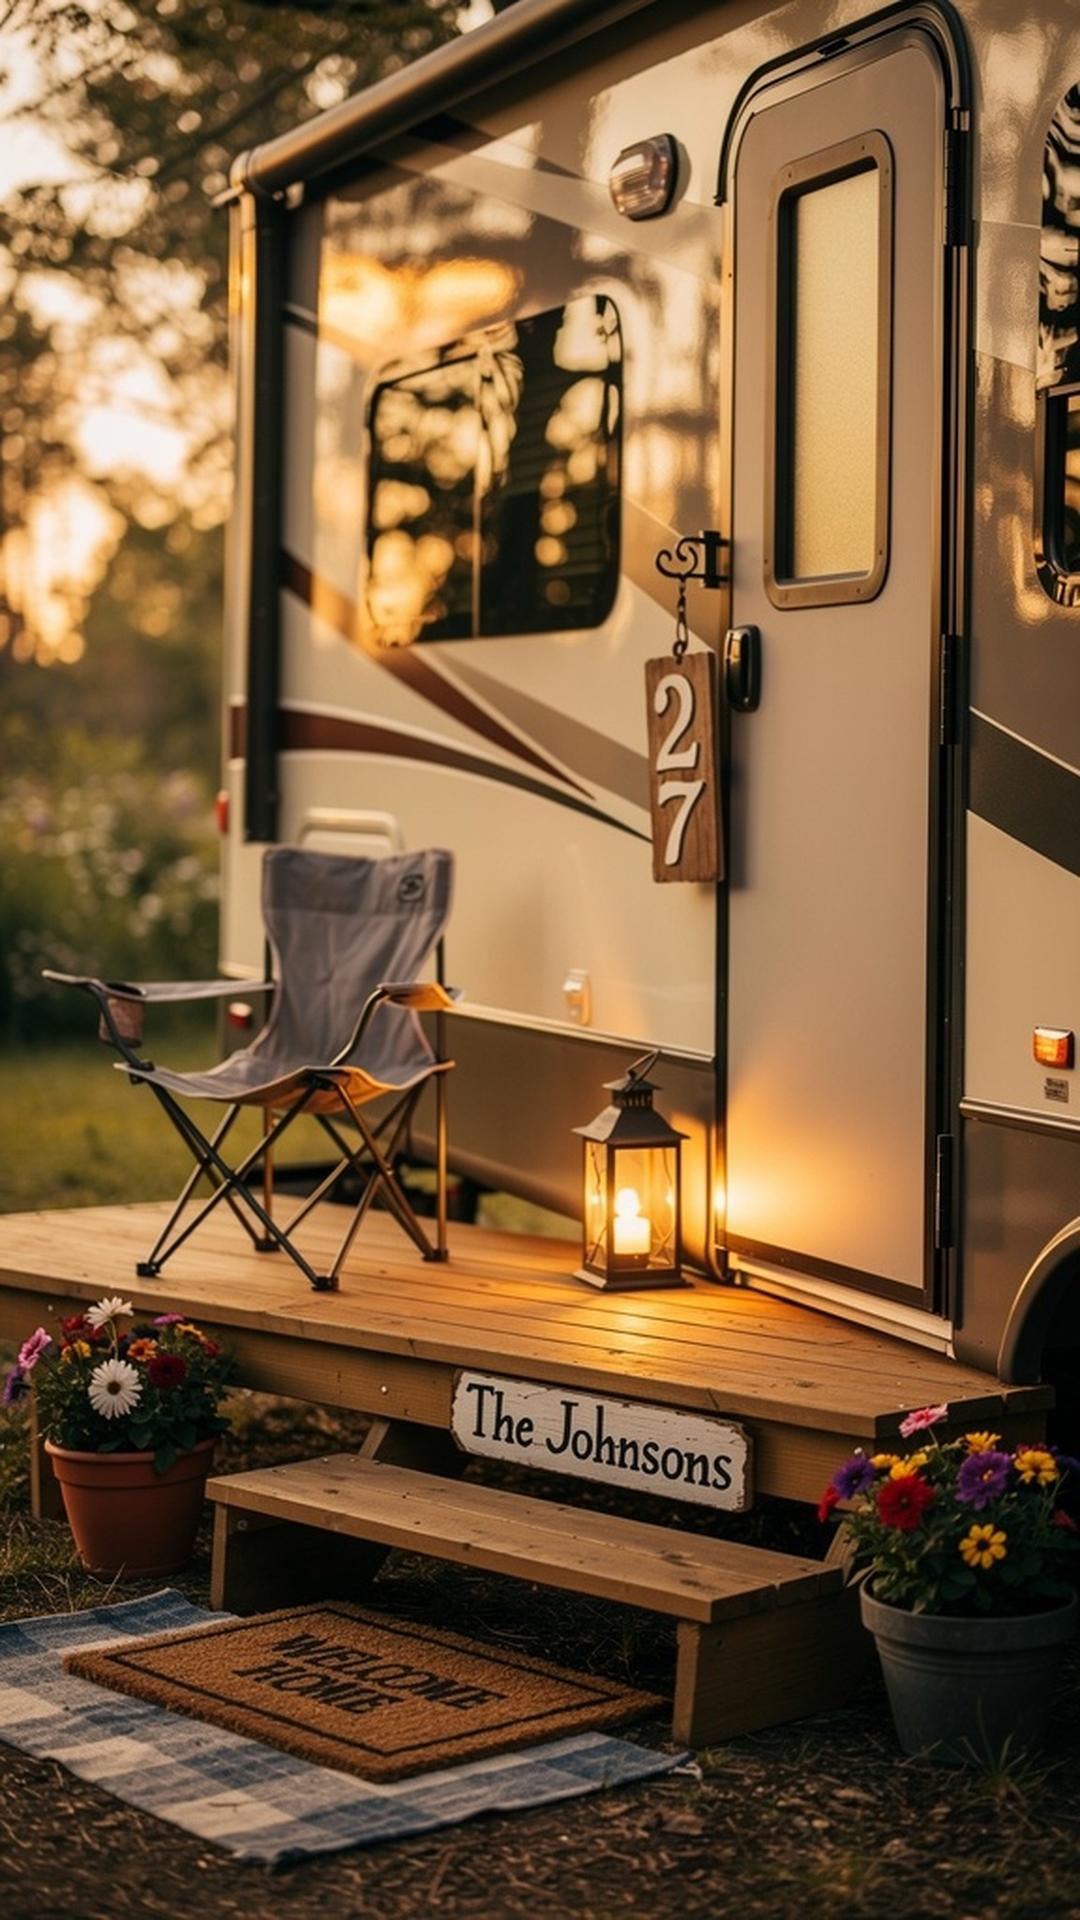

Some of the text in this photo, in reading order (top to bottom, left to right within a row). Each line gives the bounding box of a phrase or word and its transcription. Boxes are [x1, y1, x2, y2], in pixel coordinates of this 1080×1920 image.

[653, 673, 706, 867] 27
[466, 1383, 732, 1490] The Johnsons
[231, 1660, 404, 1713] HOME
[271, 1633, 509, 1710] WELCOME
